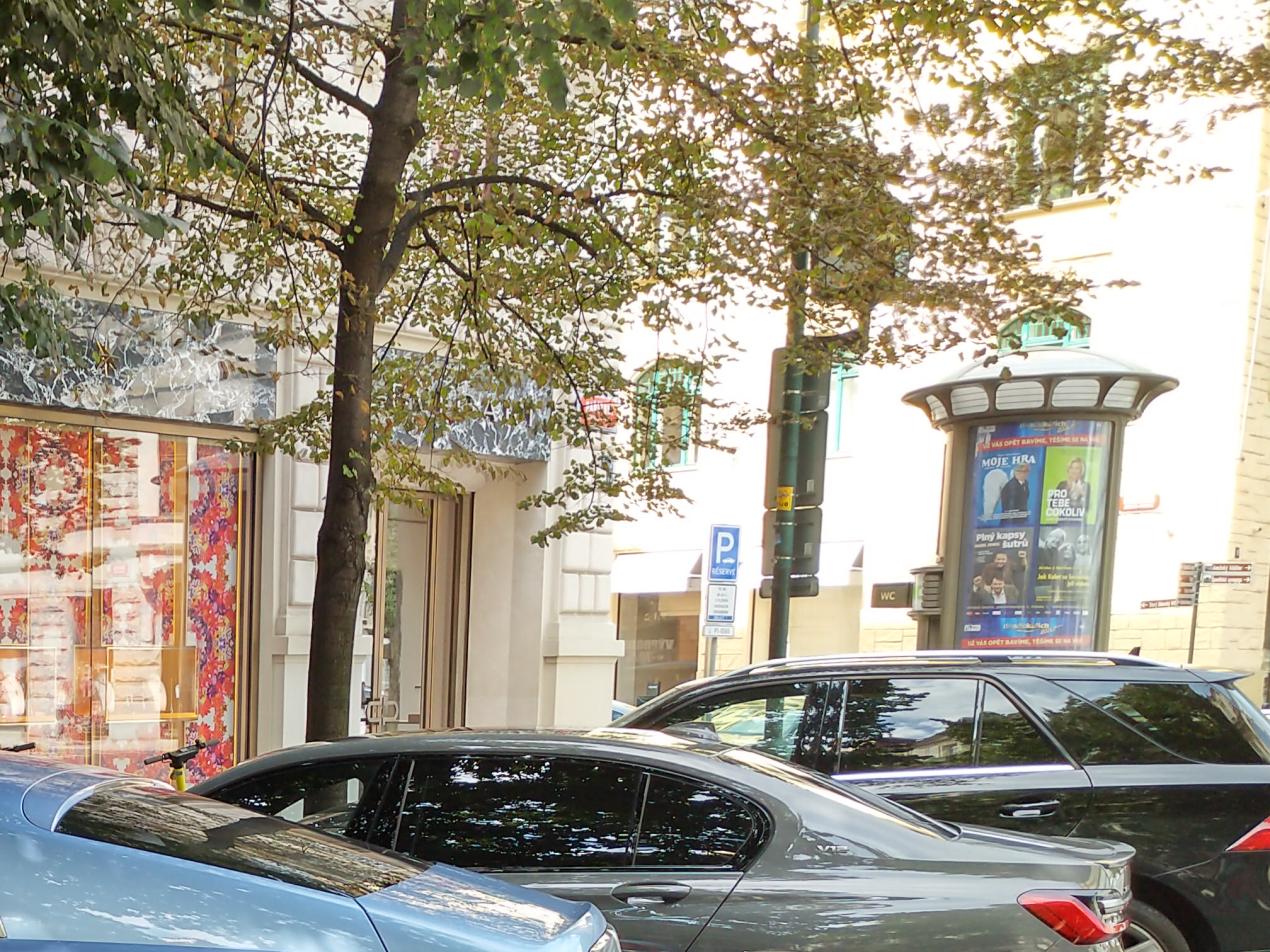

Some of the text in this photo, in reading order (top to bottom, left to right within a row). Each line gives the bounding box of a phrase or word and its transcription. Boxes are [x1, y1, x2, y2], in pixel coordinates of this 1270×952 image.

[982, 454, 1036, 468] MOJE HRA
[1047, 489, 1068, 499] PRO
[1046, 498, 1070, 508] TEBE
[1045, 507, 1085, 517] COKOLIV
[976, 530, 1026, 542] Plný kapsy
[715, 531, 735, 564] P
[1001, 538, 1029, 549] šutrů
[880, 591, 896, 601] WC
